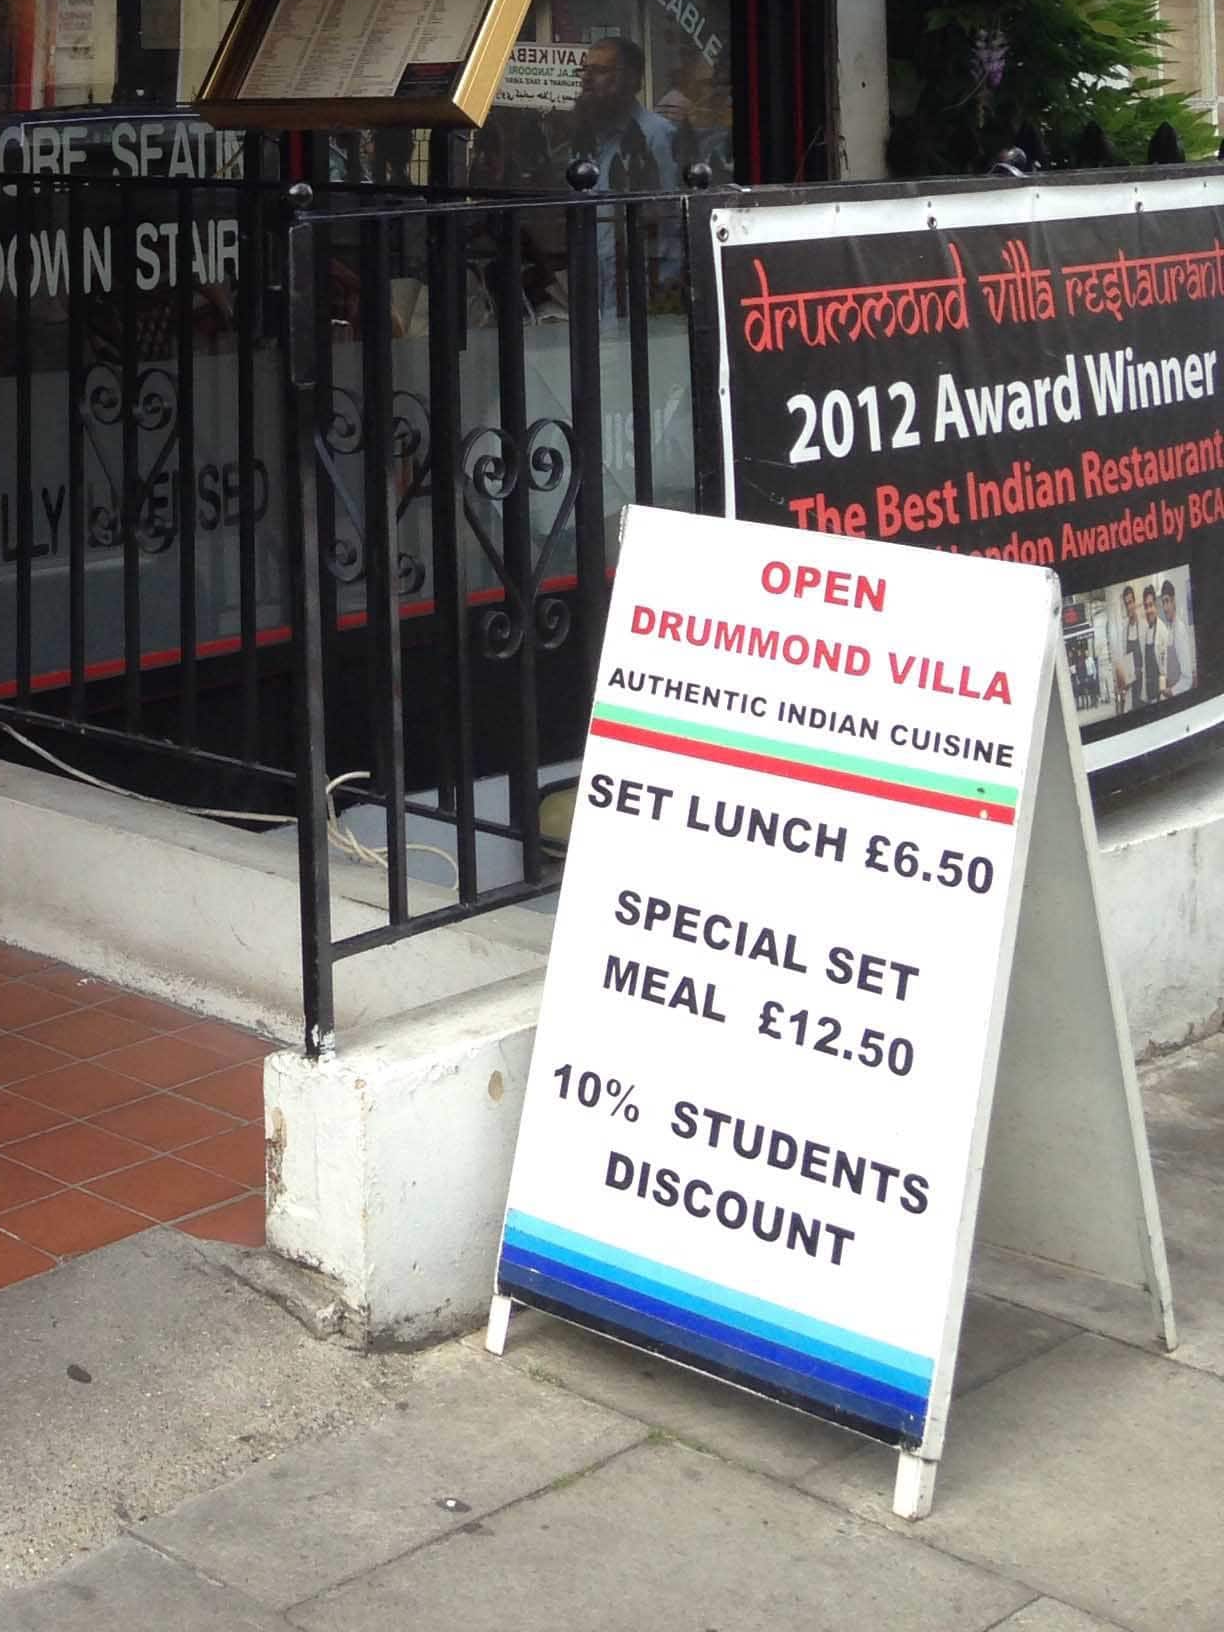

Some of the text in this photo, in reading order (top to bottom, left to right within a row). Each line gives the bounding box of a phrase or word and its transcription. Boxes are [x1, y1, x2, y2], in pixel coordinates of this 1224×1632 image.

[111, 121, 246, 186] SEATIN
[135, 218, 240, 291] STAIR
[740, 238, 1224, 353] drummond villa restaurant
[788, 347, 1218, 464] 2012 Award Winner
[789, 428, 1224, 538] The Best Indian Restaurant
[949, 532, 1054, 564] ondon
[1061, 500, 1158, 558] Awarded
[1162, 490, 1185, 543] by
[760, 560, 888, 613] OPEN
[630, 605, 1014, 706] DRUMMOND VILLA
[608, 666, 1015, 768] AUTHENTIC INDIAN CUISINE
[588, 773, 995, 895] SET LUNCH £6.50
[614, 889, 919, 1003] SPECIAL SET
[603, 955, 915, 1078] MEAL £12.50
[553, 1064, 931, 1216] 10% STUDENTS
[605, 1150, 855, 1266] DISCOUNT
